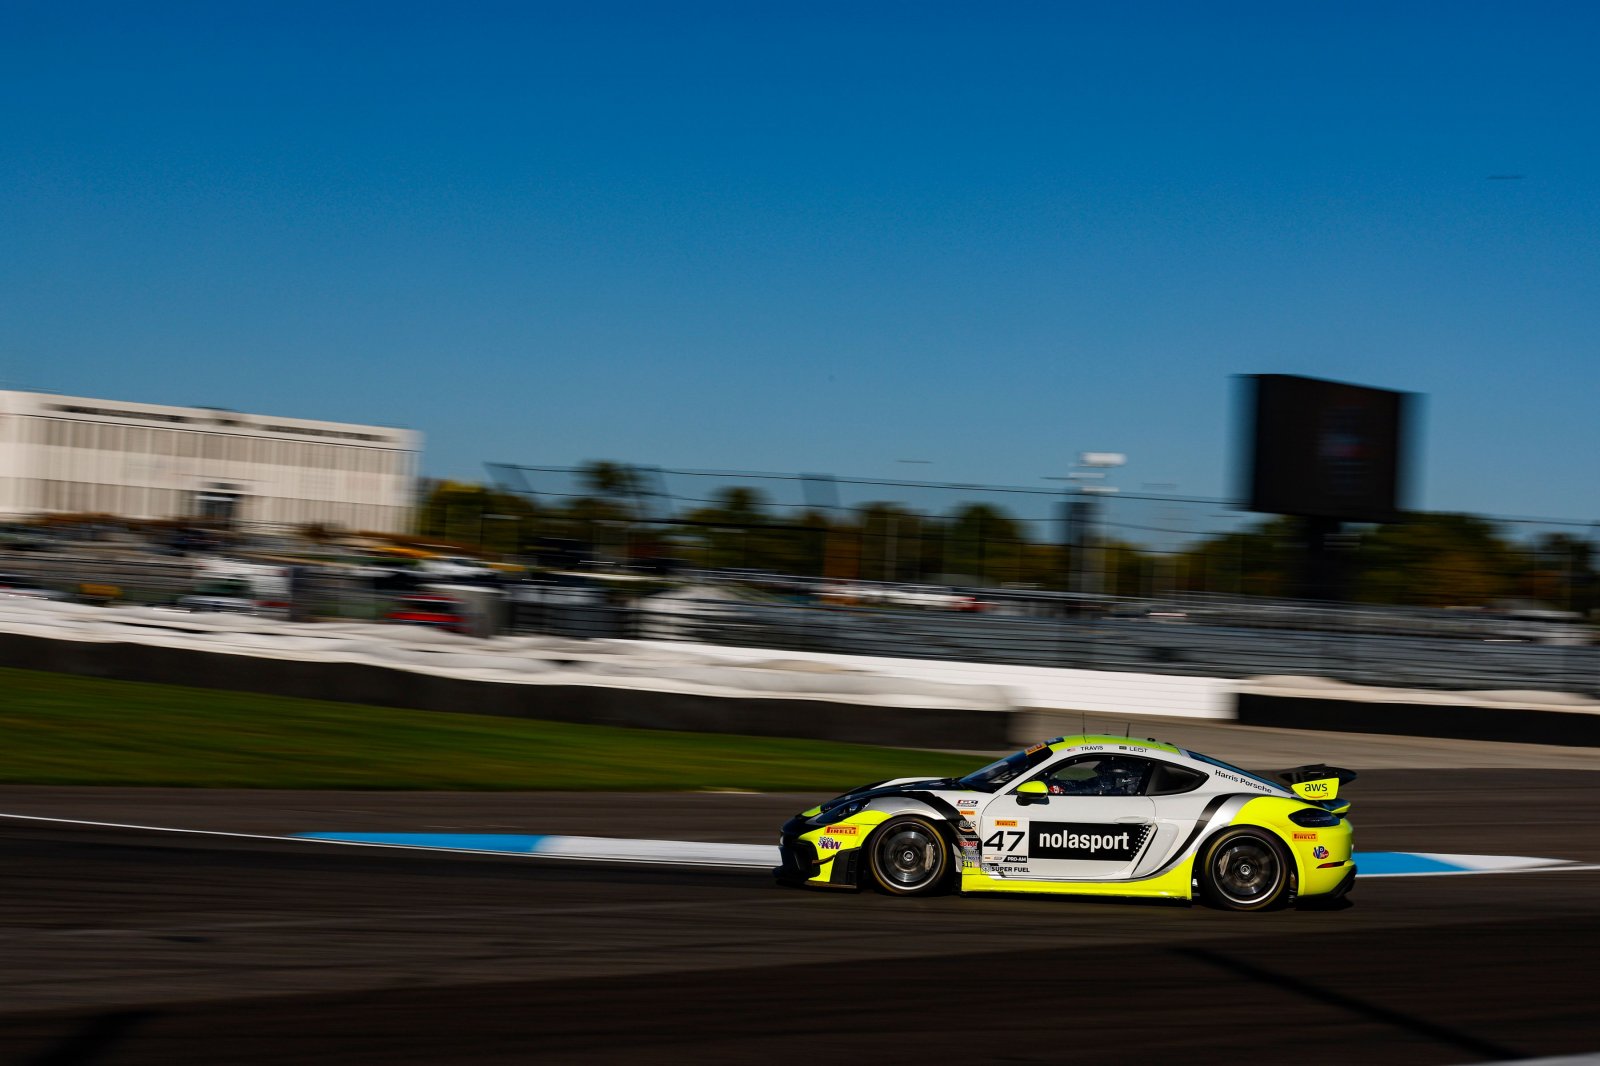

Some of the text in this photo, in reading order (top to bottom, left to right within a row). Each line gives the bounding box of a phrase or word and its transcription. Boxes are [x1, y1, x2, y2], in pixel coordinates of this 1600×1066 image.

[1214, 770, 1272, 794] Harris Porsche
[1304, 782, 1328, 792] aws
[826, 826, 856, 834] PIRELLI
[984, 830, 1026, 852] 47
[1039, 830, 1130, 852] nolasport
